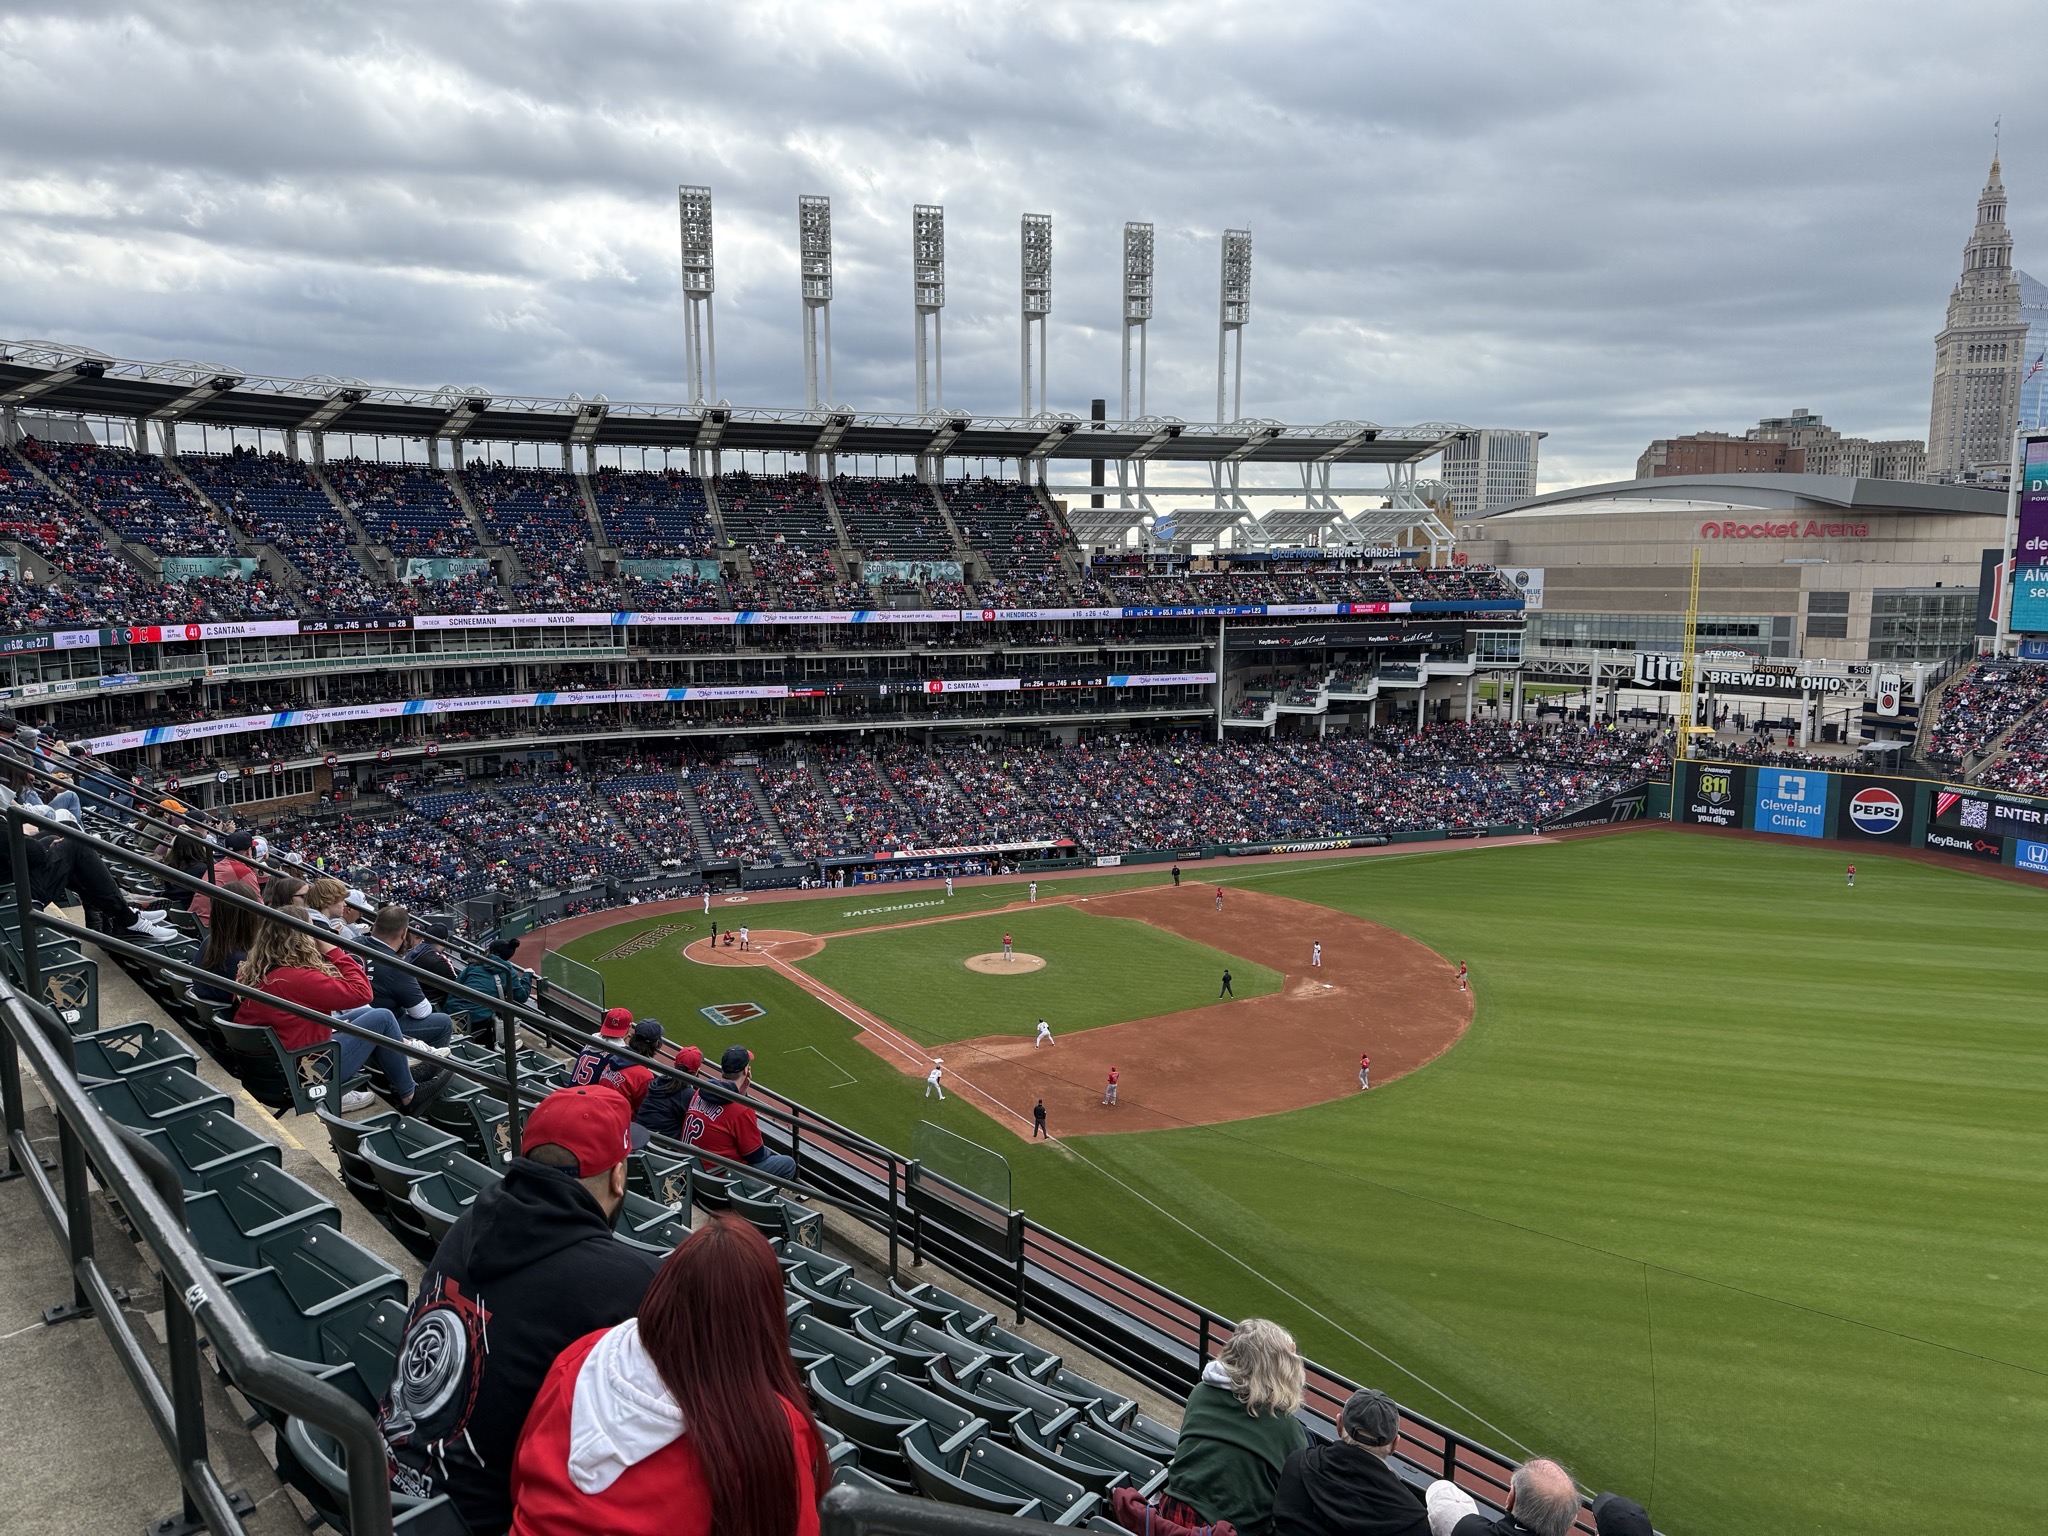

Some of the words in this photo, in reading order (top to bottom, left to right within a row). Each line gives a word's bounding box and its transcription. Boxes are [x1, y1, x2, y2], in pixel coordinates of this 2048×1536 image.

[1722, 521, 1798, 539] Rocket
[1802, 520, 1869, 538] Arena
[1272, 547, 1296, 560] BLUE
[1296, 549, 1319, 558] MOON
[1323, 548, 1362, 558] TERRACE
[1364, 547, 1400, 558] GARDEN
[169, 562, 205, 574] SEWELL
[1381, 604, 1386, 612] 4
[547, 616, 575, 624] NAYLOR
[984, 611, 993, 619] 28
[312, 622, 328, 631] .254
[344, 620, 360, 630] .745
[373, 620, 379, 628] 6
[397, 619, 407, 628] 28
[449, 617, 497, 626] SCHNEEMANN
[139, 627, 148, 643] C
[189, 628, 198, 637] 41
[206, 627, 213, 636] C.
[213, 625, 245, 635] SANTANA
[11, 639, 23, 650] 6.02
[36, 637, 48, 648] 2.77
[79, 634, 90, 644] 0-0
[1704, 650, 1746, 658] SERVPRO
[1631, 653, 1687, 687] Lite
[1753, 665, 1797, 675] PROUDLY
[1854, 666, 1870, 674] 5:06
[932, 683, 940, 691] 41
[1710, 671, 1776, 687] BREWED
[1780, 676, 1796, 689] IN
[1800, 677, 1841, 691] OHIO
[1880, 681, 1899, 694] Lite
[273, 764, 282, 772] 21
[1701, 775, 1727, 795] 811
[1943, 786, 1980, 797] PROGRESSIVE
[1995, 793, 2034, 805] PROGRESSIVE
[1691, 804, 1707, 814] Call
[1709, 806, 1736, 816] before
[1760, 799, 1821, 815] Cleveland
[1853, 804, 1900, 818] PEPSI
[1697, 815, 1713, 824] you
[1713, 815, 1728, 826] dig.
[1995, 805, 2041, 824] ENTER
[1542, 823, 1572, 832] TECHNICALLY,
[1573, 820, 1590, 828] PEOPLE
[1590, 818, 1608, 826] MATTER
[1772, 814, 1807, 828] Clinic
[1286, 841, 1336, 853] CONRAD'S
[1927, 833, 1973, 850] KeyBank
[904, 844, 998, 856] CLEVELAND
[843, 899, 945, 918] PROGRESSIVE
[65, 1011, 74, 1021] E
[572, 1053, 600, 1086] 15
[314, 1088, 322, 1096] D
[689, 1093, 723, 1122] LINDOR
[682, 1113, 705, 1145] 12
